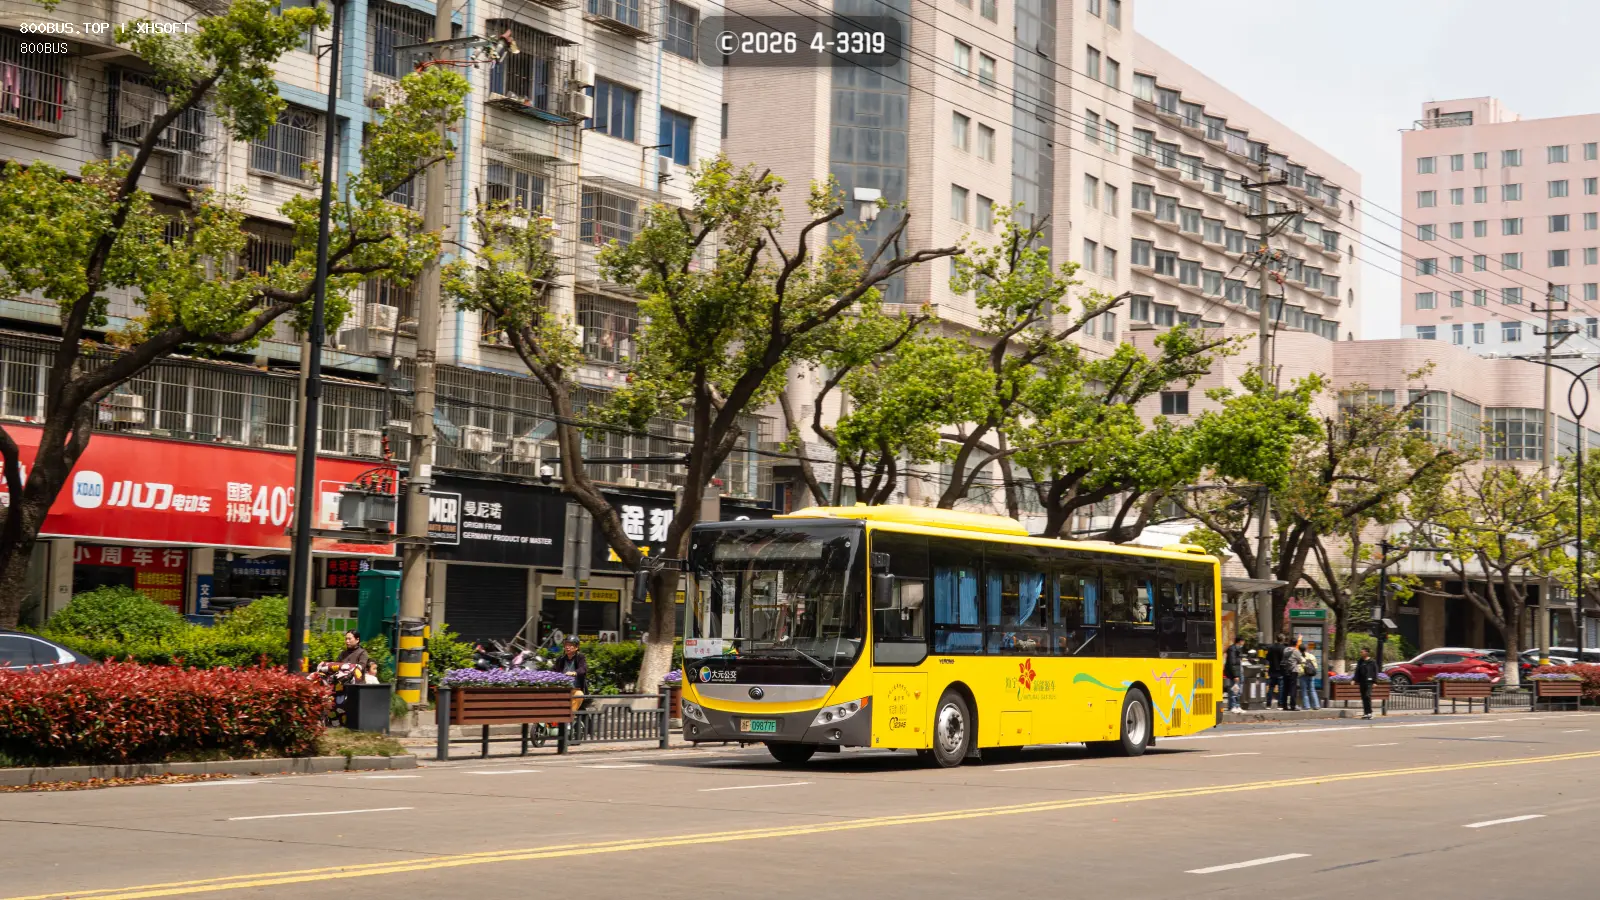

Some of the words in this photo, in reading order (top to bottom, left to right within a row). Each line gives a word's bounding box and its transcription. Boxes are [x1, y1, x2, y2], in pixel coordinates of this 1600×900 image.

[227, 481, 253, 502] 国家
[226, 503, 252, 523] 补贴
[464, 501, 503, 520] 曼尼诺
[485, 522, 502, 531] FROM
[462, 531, 492, 541] GERMANY
[493, 534, 520, 543] PRODUCT
[520, 536, 529, 544] OF
[529, 537, 553, 546] MASTER
[73, 545, 184, 568] 小周车行
[711, 670, 737, 679] 大元公交
